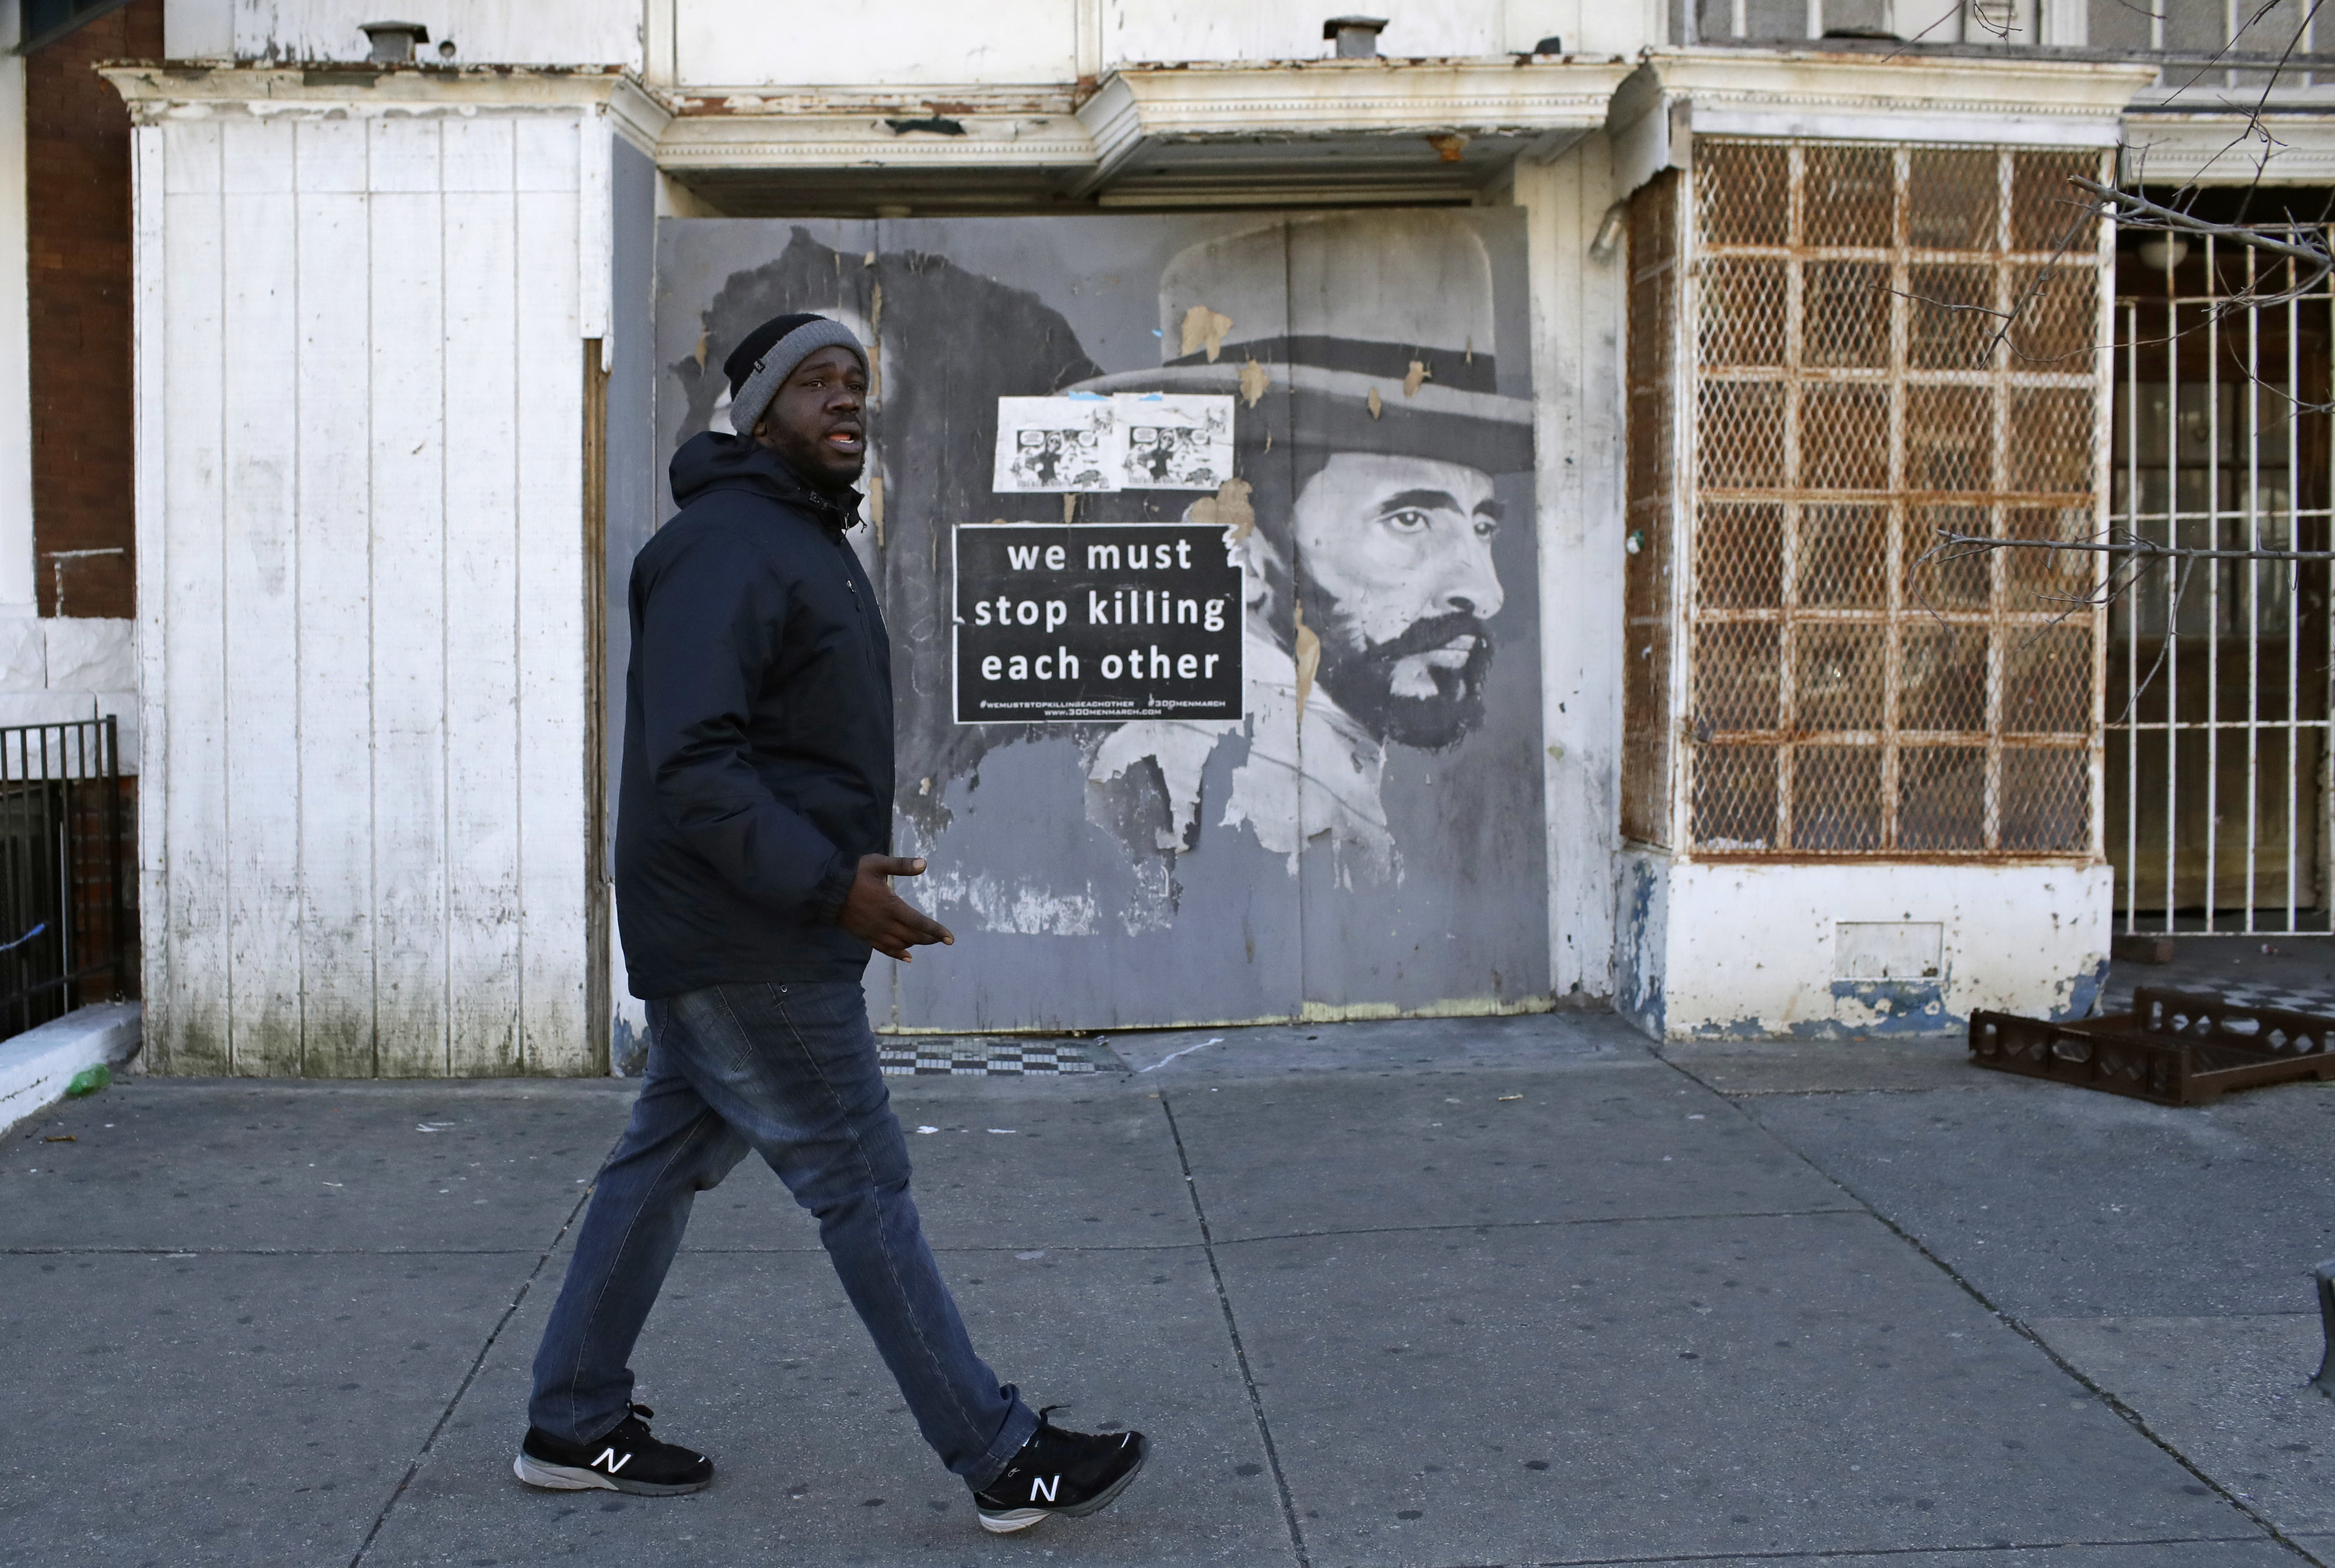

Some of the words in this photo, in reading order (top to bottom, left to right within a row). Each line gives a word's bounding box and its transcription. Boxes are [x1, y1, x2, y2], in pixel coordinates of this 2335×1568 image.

[1007, 545, 1065, 570] we
[1088, 539, 1191, 570] must
[975, 596, 1067, 633] stop
[1089, 590, 1225, 632] killing
[982, 646, 1079, 680] each
[1101, 645, 1219, 679] other
[591, 1447, 631, 1473] N
[1030, 1475, 1060, 1501] N
